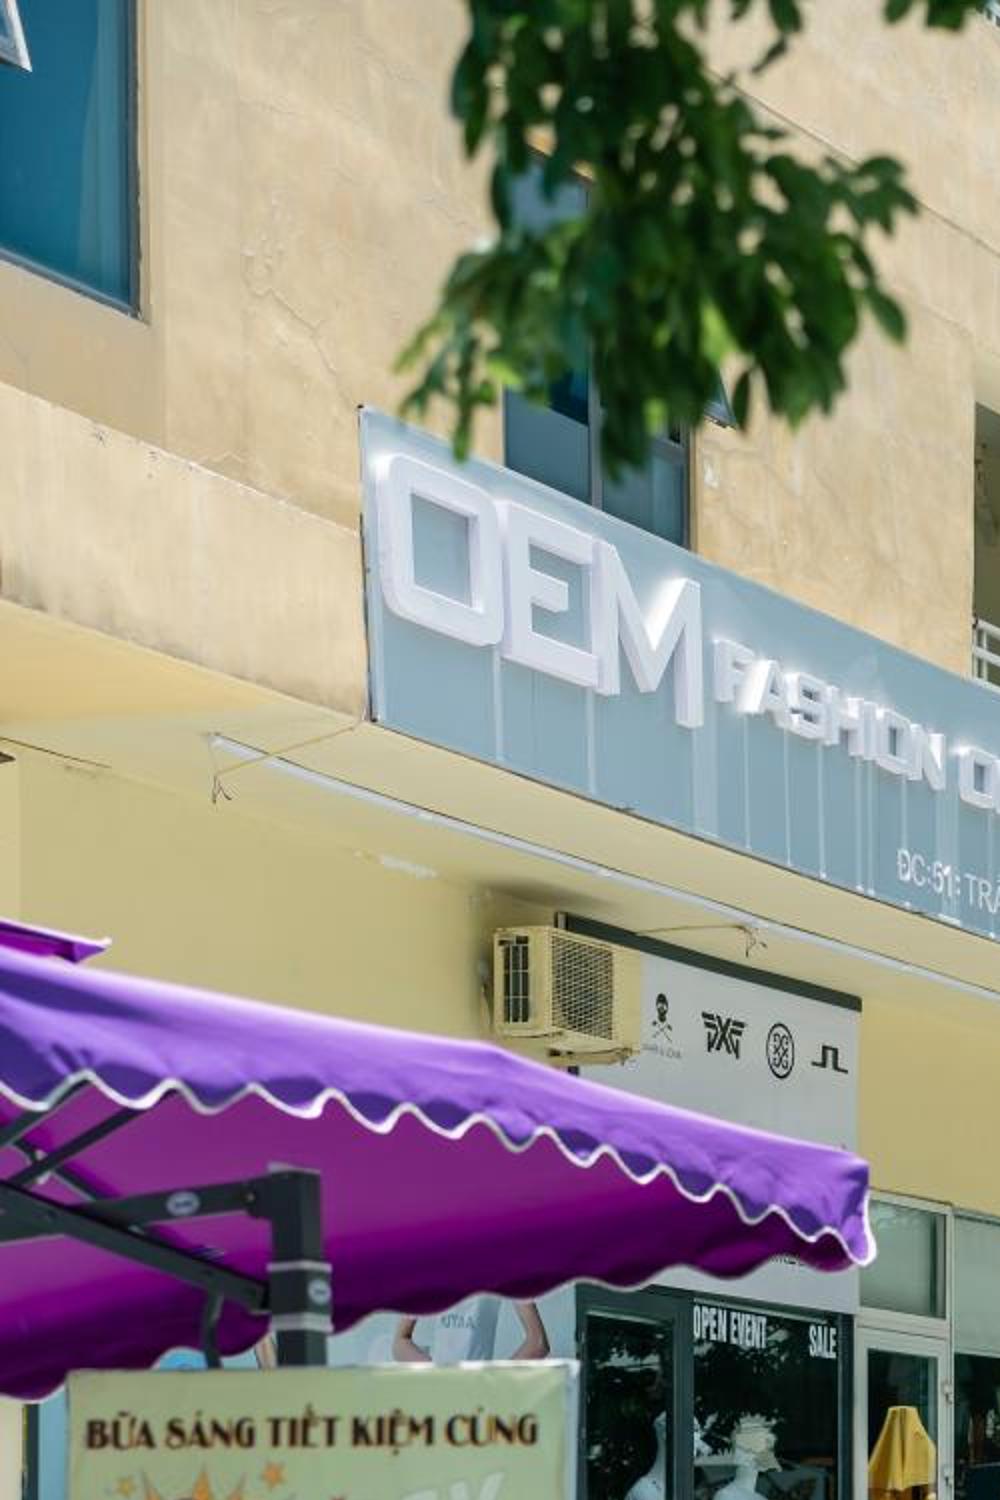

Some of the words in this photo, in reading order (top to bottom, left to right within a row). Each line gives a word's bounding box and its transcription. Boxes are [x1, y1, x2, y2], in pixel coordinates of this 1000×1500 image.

[375, 453, 703, 729] OEM
[712, 637, 947, 792] FASHION
[692, 1305, 727, 1343] OPEN
[730, 1311, 767, 1349] EVENT
[809, 1325, 837, 1359] SALE
[86, 1410, 156, 1450] BỮA
[165, 1410, 256, 1450] SÁNG
[352, 1407, 434, 1456] KIỆM
